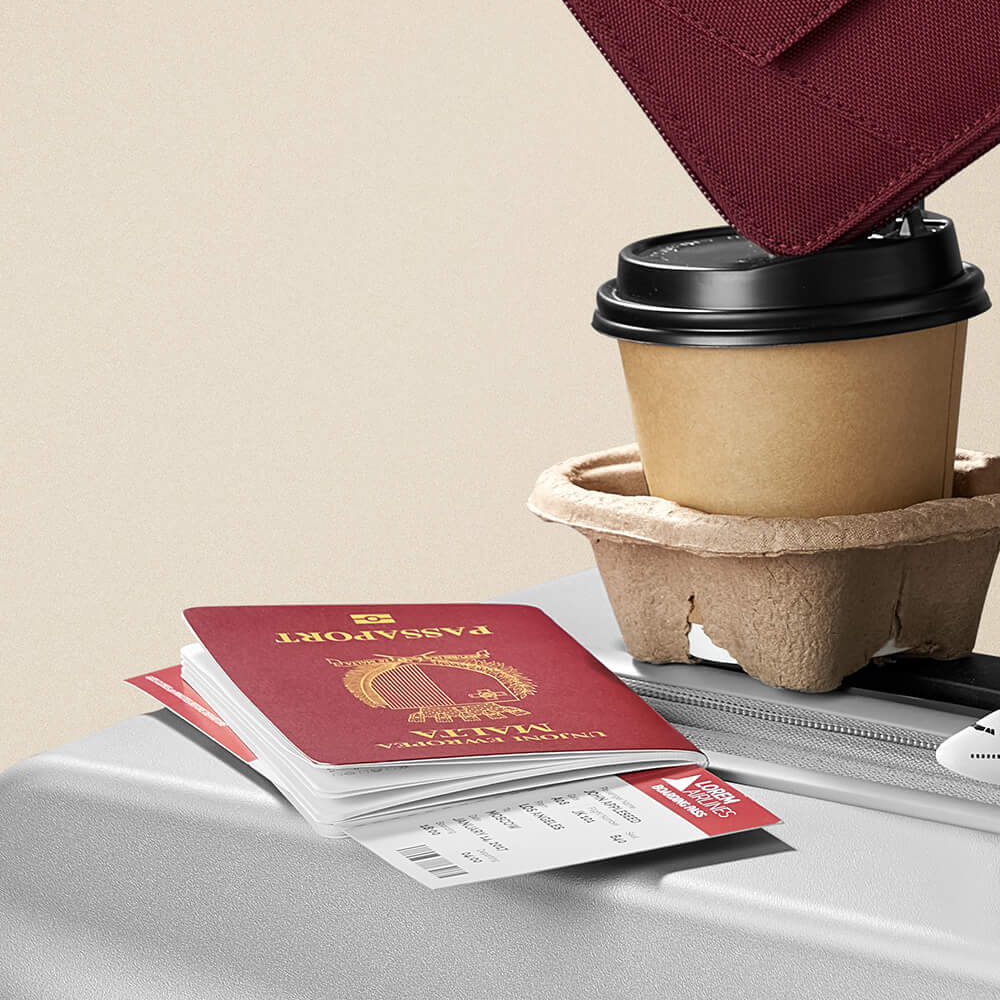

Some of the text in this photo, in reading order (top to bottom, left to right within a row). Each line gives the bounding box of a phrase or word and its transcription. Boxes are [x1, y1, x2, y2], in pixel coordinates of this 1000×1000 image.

[274, 625, 495, 643] PASSAPORT
[409, 722, 554, 739] MALTA
[376, 731, 608, 750] UNJONI EWROPEA
[695, 780, 741, 804] LOREM
[682, 789, 737, 817] AIRLINES
[683, 803, 708, 818] PASS
